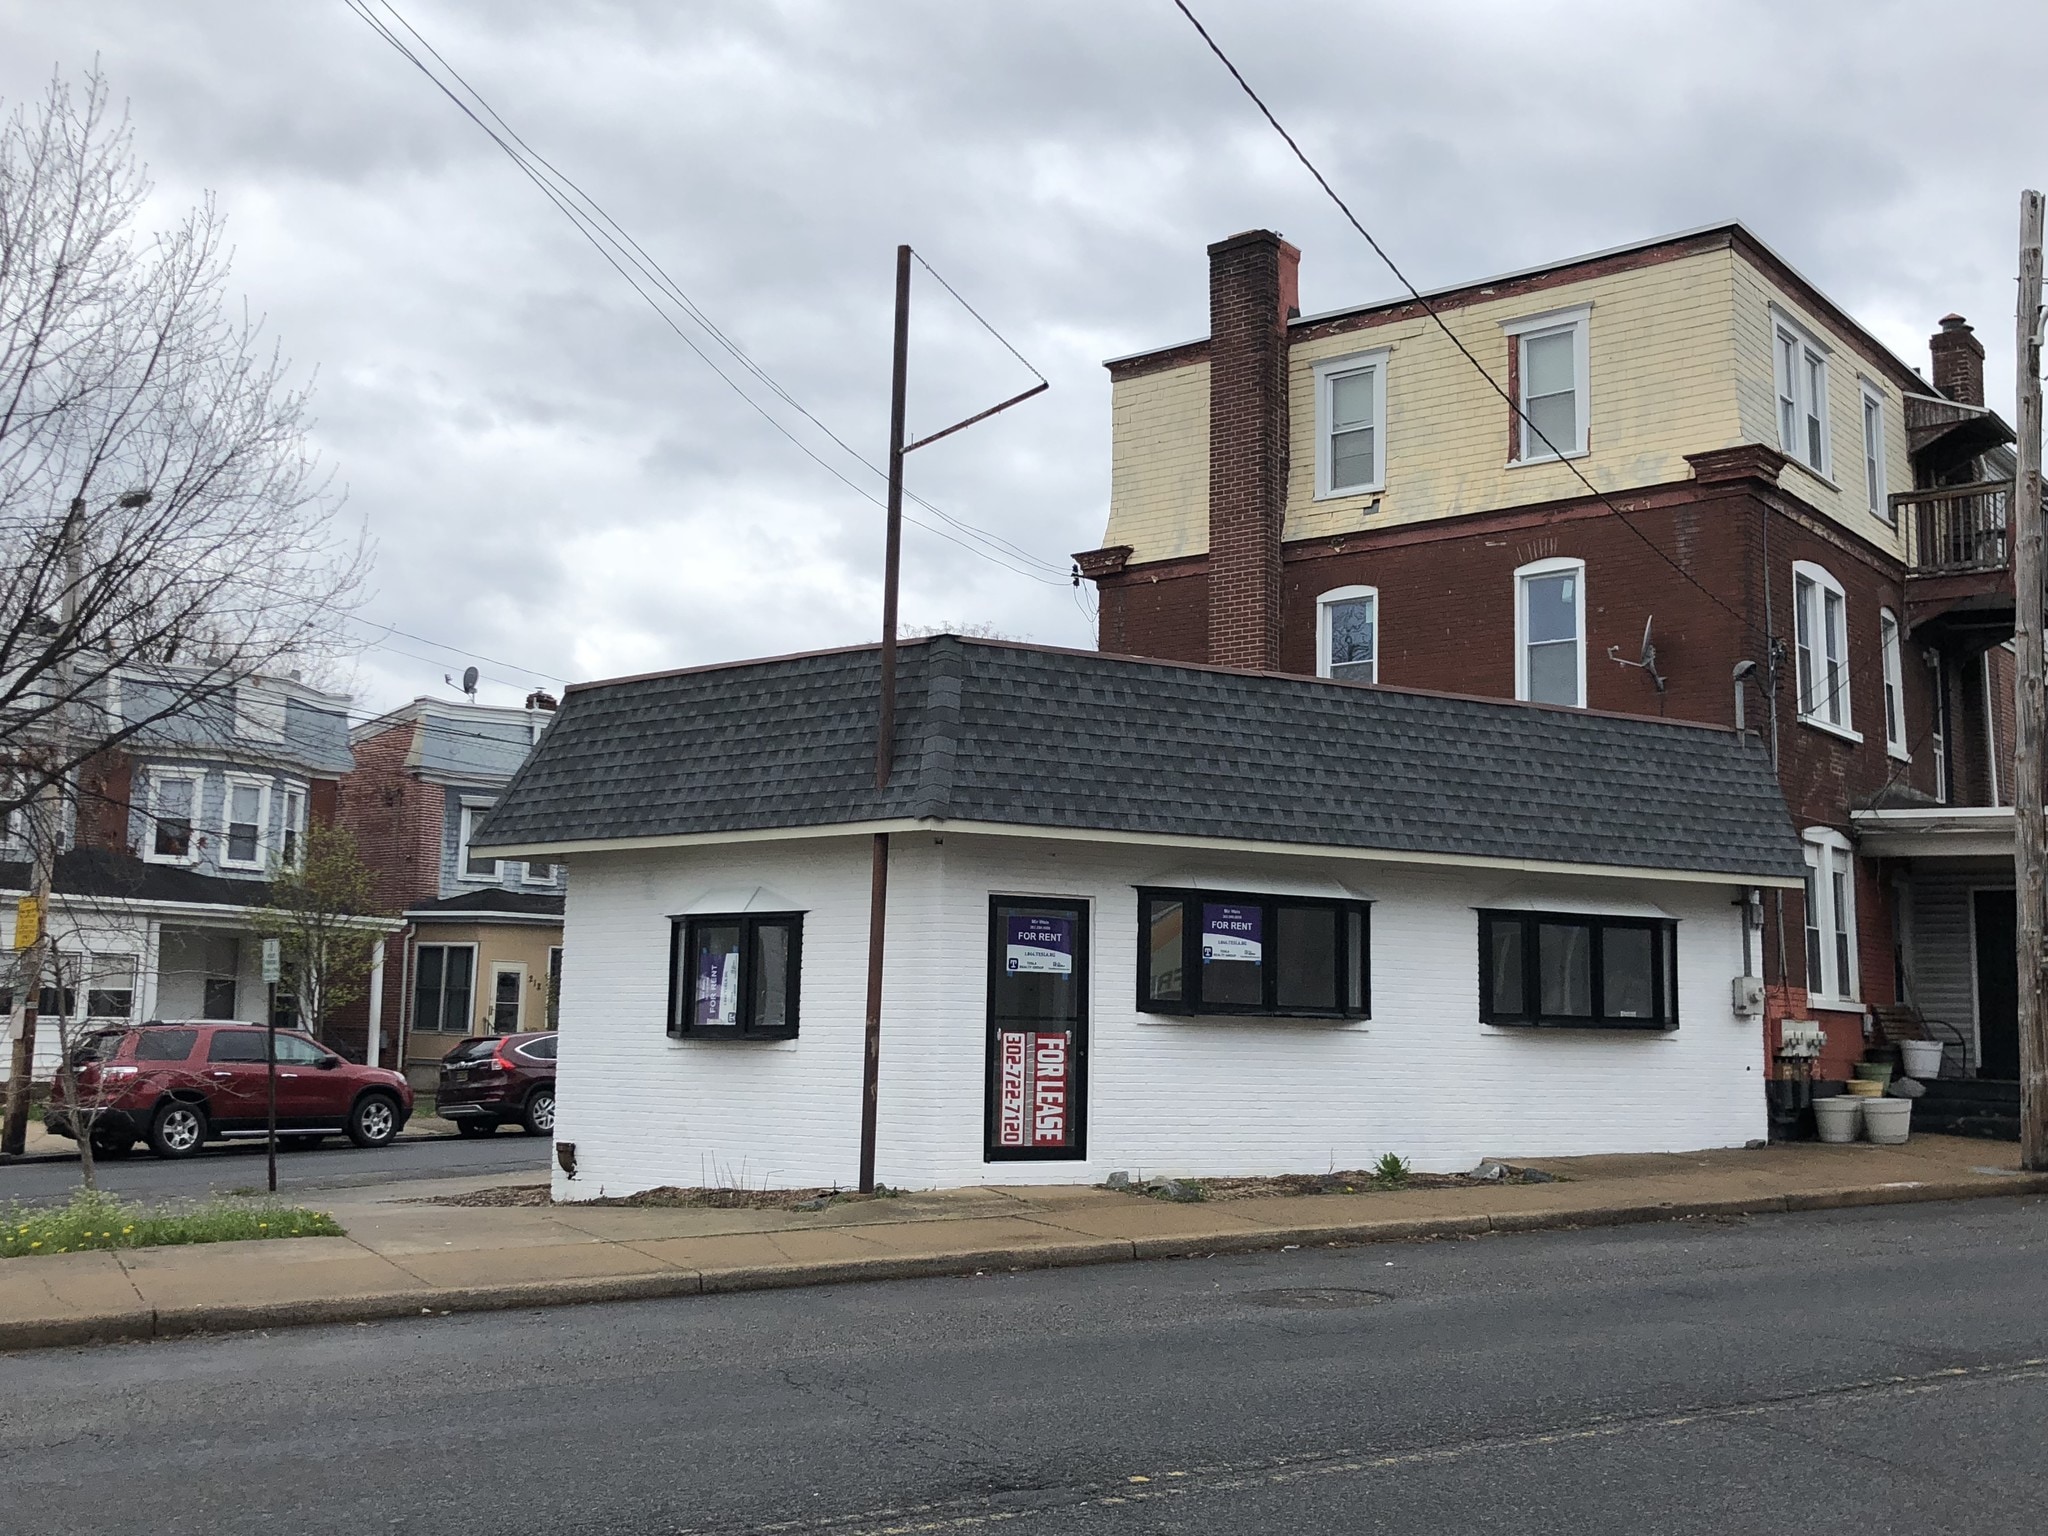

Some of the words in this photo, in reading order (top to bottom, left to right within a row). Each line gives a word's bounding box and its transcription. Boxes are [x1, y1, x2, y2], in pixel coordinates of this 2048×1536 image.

[1018, 931, 1037, 941] FOR
[1038, 932, 1062, 942] RENT
[1211, 920, 1229, 929] FOR
[1230, 921, 1253, 931] RENT
[710, 964, 718, 990] RENT
[709, 993, 717, 1014] FOR
[1037, 1038, 1065, 1077] FOR
[1004, 1034, 1021, 1142] 302-722-7120
[1035, 1081, 1064, 1141] LEASE
